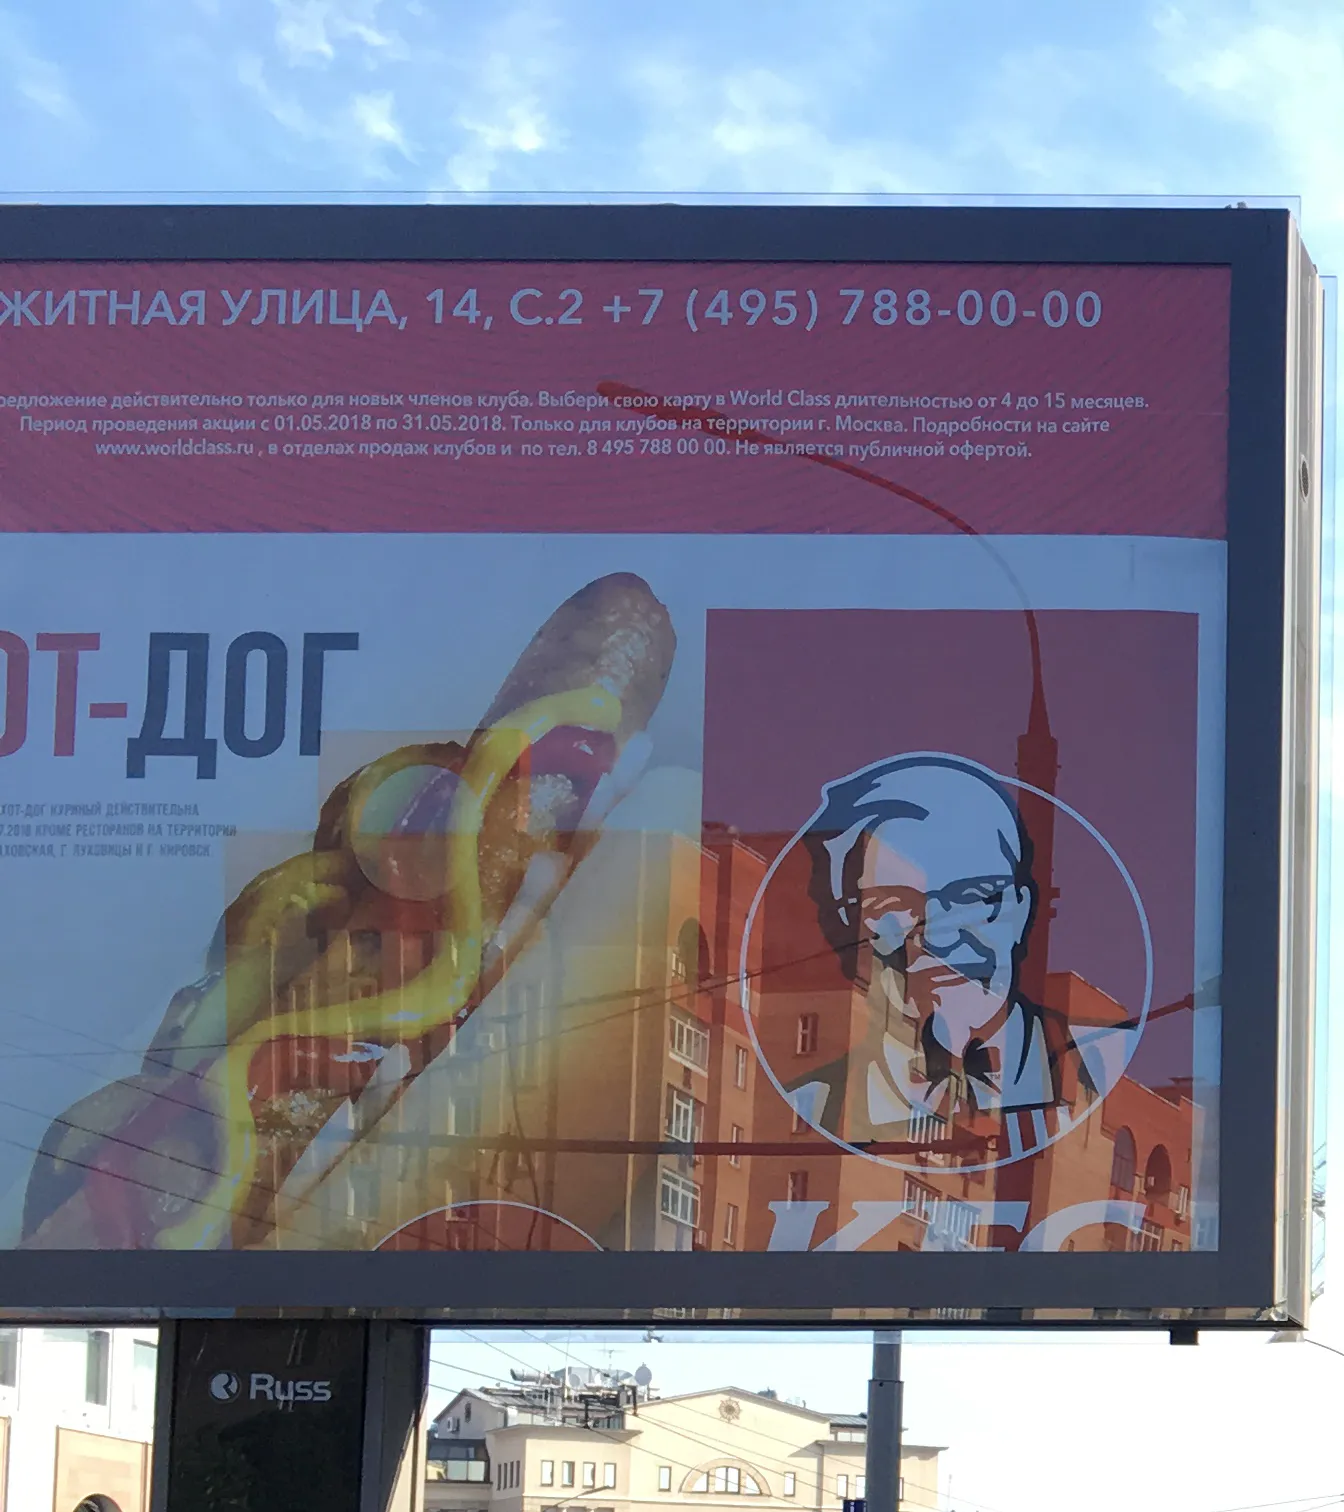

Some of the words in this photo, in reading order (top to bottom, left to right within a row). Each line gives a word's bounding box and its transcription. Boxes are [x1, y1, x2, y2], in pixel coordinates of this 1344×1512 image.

[0, 289, 206, 328] ЖИТНАЯ
[220, 289, 408, 334] УЛИЦА,
[427, 289, 494, 332] 14,
[510, 288, 584, 327] С.2
[603, 289, 665, 327] +7
[686, 288, 820, 334] (495)
[840, 289, 1103, 330] 788-00-00
[110, 391, 243, 409] действительно
[248, 394, 308, 408] только
[311, 394, 345, 409] для
[349, 394, 405, 407] новых
[408, 394, 473, 407] членов
[477, 390, 534, 411] клуба.
[538, 390, 610, 411] Выбери
[613, 395, 659, 408] свою
[663, 395, 712, 411] карту
[716, 395, 726, 407] в
[730, 390, 783, 407] World
[787, 390, 831, 407] Class
[834, 394, 974, 410] длительностью
[977, 396, 998, 409] от
[1001, 392, 1013, 408] 4
[1015, 395, 1040, 410] до
[1044, 392, 1067, 409] 15
[1070, 395, 1150, 412] месяцев.
[20, 415, 88, 436] Период
[92, 418, 199, 436] проведения
[202, 417, 257, 433] акции
[260, 420, 269, 432] с
[274, 415, 372, 432] 01.05.2018
[376, 419, 398, 432] по
[402, 414, 506, 432] 31.05.2018.
[511, 415, 575, 432] Только
[578, 420, 611, 434] для
[616, 415, 678, 436] клубов
[681, 419, 702, 431] на
[706, 419, 814, 436] территории
[818, 421, 831, 432] г.
[835, 416, 908, 433] Москва.
[912, 417, 1032, 438] Подробности
[1036, 420, 1058, 433] на
[1062, 418, 1110, 434] сайте
[95, 438, 254, 457] www.worldclass.ru
[268, 443, 279, 456] в
[283, 443, 355, 457] отделах
[358, 442, 429, 460] продаж
[433, 439, 497, 461] клубов
[501, 444, 513, 456] и
[521, 444, 544, 457] по
[547, 444, 582, 457] тел.
[586, 439, 598, 456] 8
[602, 439, 635, 456] 495
[639, 439, 673, 456] 788
[676, 438, 700, 456] 00
[703, 438, 731, 457] 00.
[735, 439, 760, 457] Не
[763, 443, 845, 457] является
[849, 439, 946, 462] публичной
[948, 439, 1033, 461] офертой.
